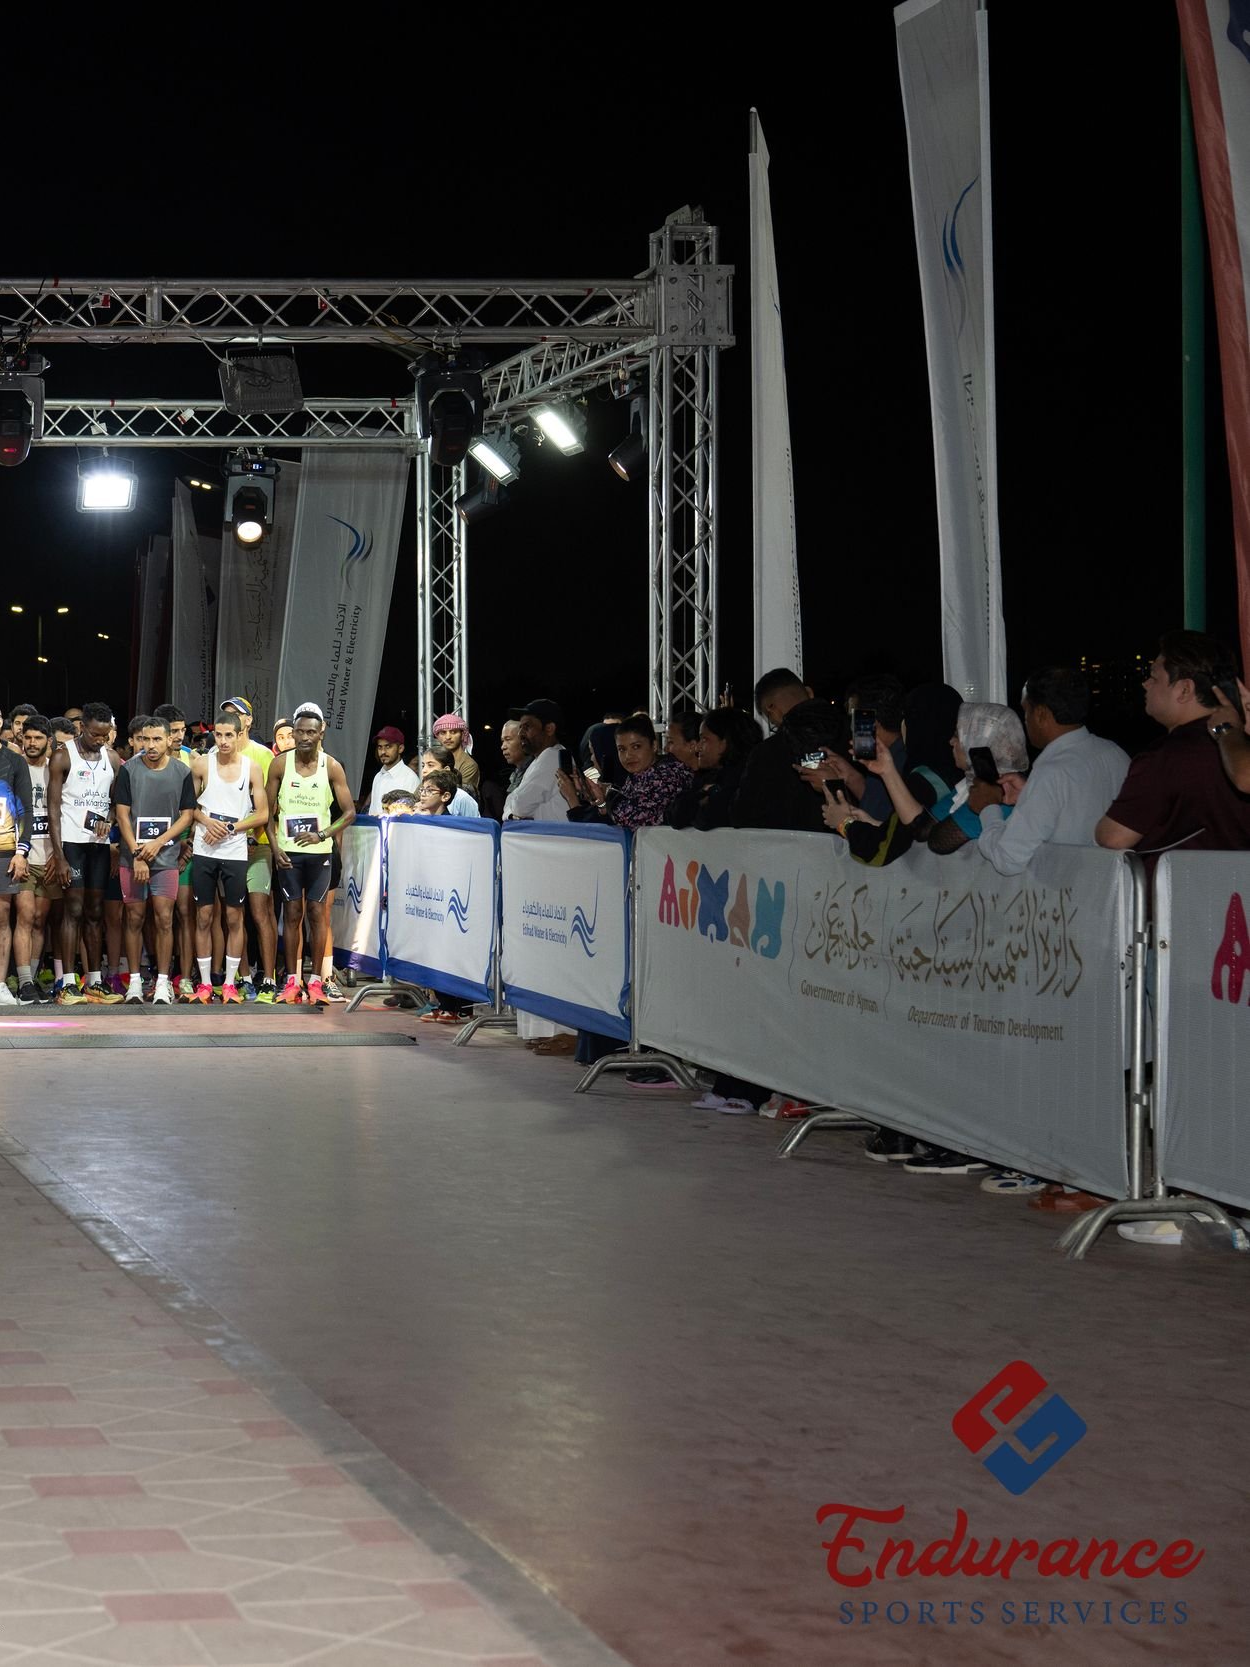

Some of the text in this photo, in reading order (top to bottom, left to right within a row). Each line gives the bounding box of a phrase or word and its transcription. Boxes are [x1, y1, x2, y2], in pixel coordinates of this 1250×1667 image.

[336, 605, 362, 730] Etihad Water & Electricity
[32, 822, 48, 830] 167
[148, 827, 159, 836] 39
[293, 824, 312, 833] 127
[801, 979, 846, 1006] Government
[907, 1005, 1064, 1045] Department of Tourism Development
